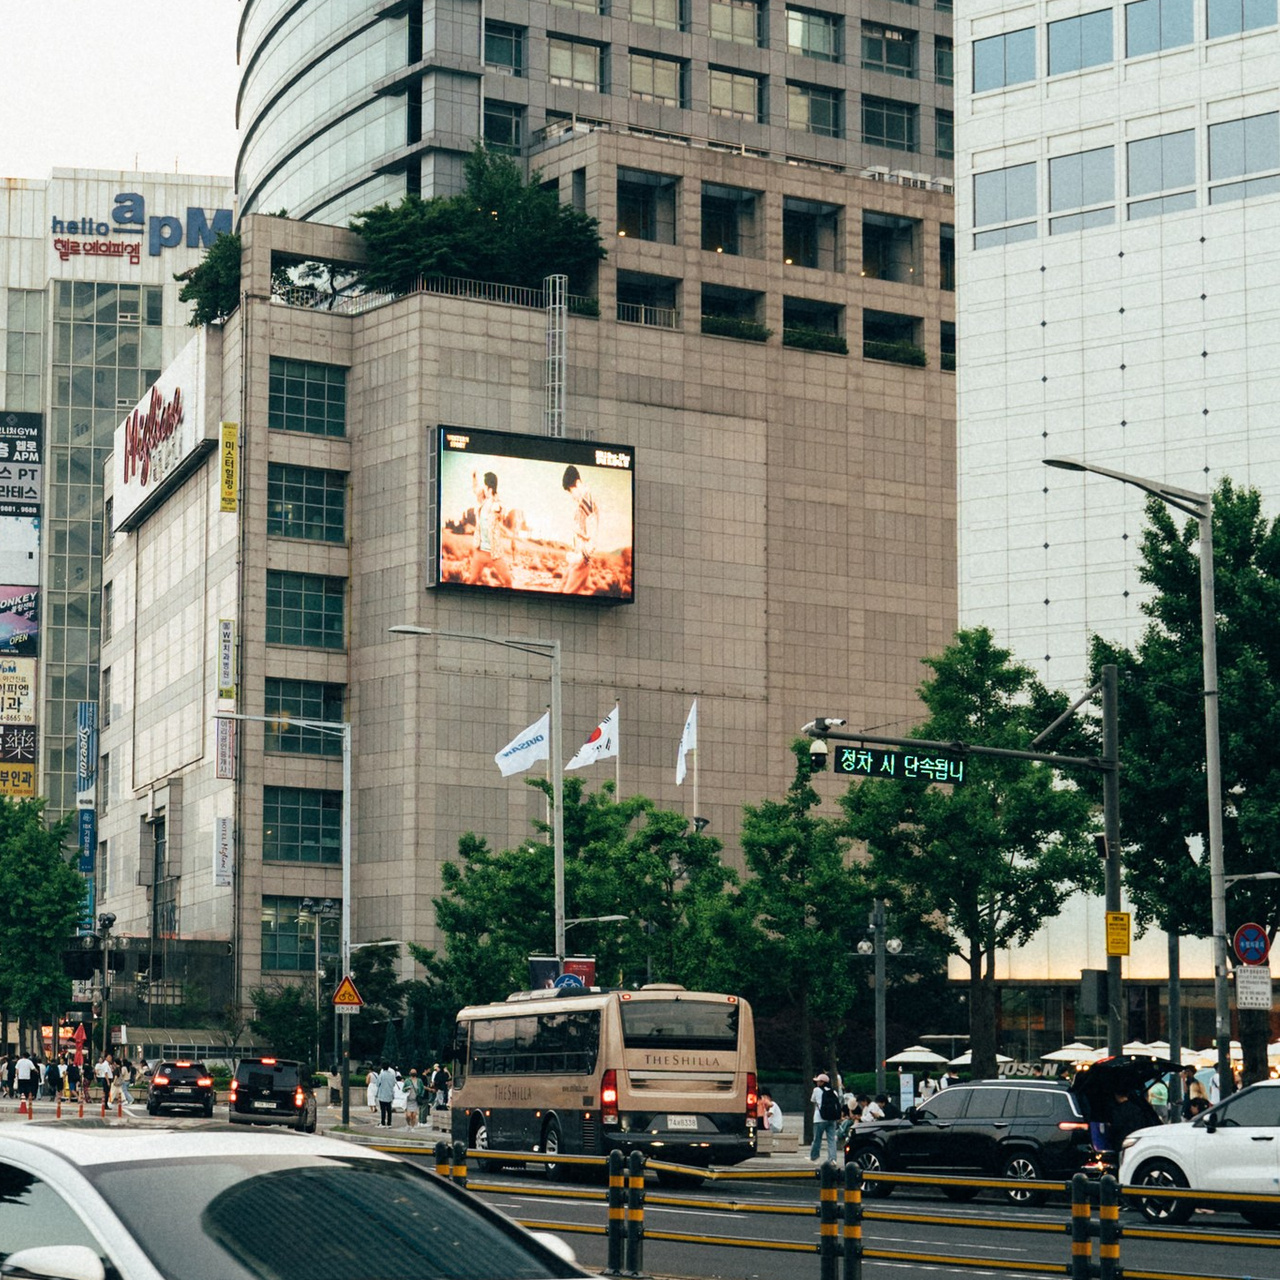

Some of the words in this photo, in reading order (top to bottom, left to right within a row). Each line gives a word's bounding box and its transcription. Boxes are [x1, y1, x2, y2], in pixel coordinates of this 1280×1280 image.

[52, 215, 110, 236] hello
[112, 192, 234, 257] apM
[54, 237, 81, 261] 헬로
[83, 240, 140, 265] 에이피엠
[13, 452, 39, 462] APM
[16, 440, 37, 452] 헬로
[18, 468, 38, 480] PT
[224, 441, 235, 490] 미스터힐링
[9, 633, 29, 646] OPEN
[79, 725, 91, 779] Speezon
[840, 748, 873, 773] 정차
[880, 753, 895, 776] 시
[904, 755, 964, 783] 단속됩니
[83, 830, 91, 857] 기업은행
